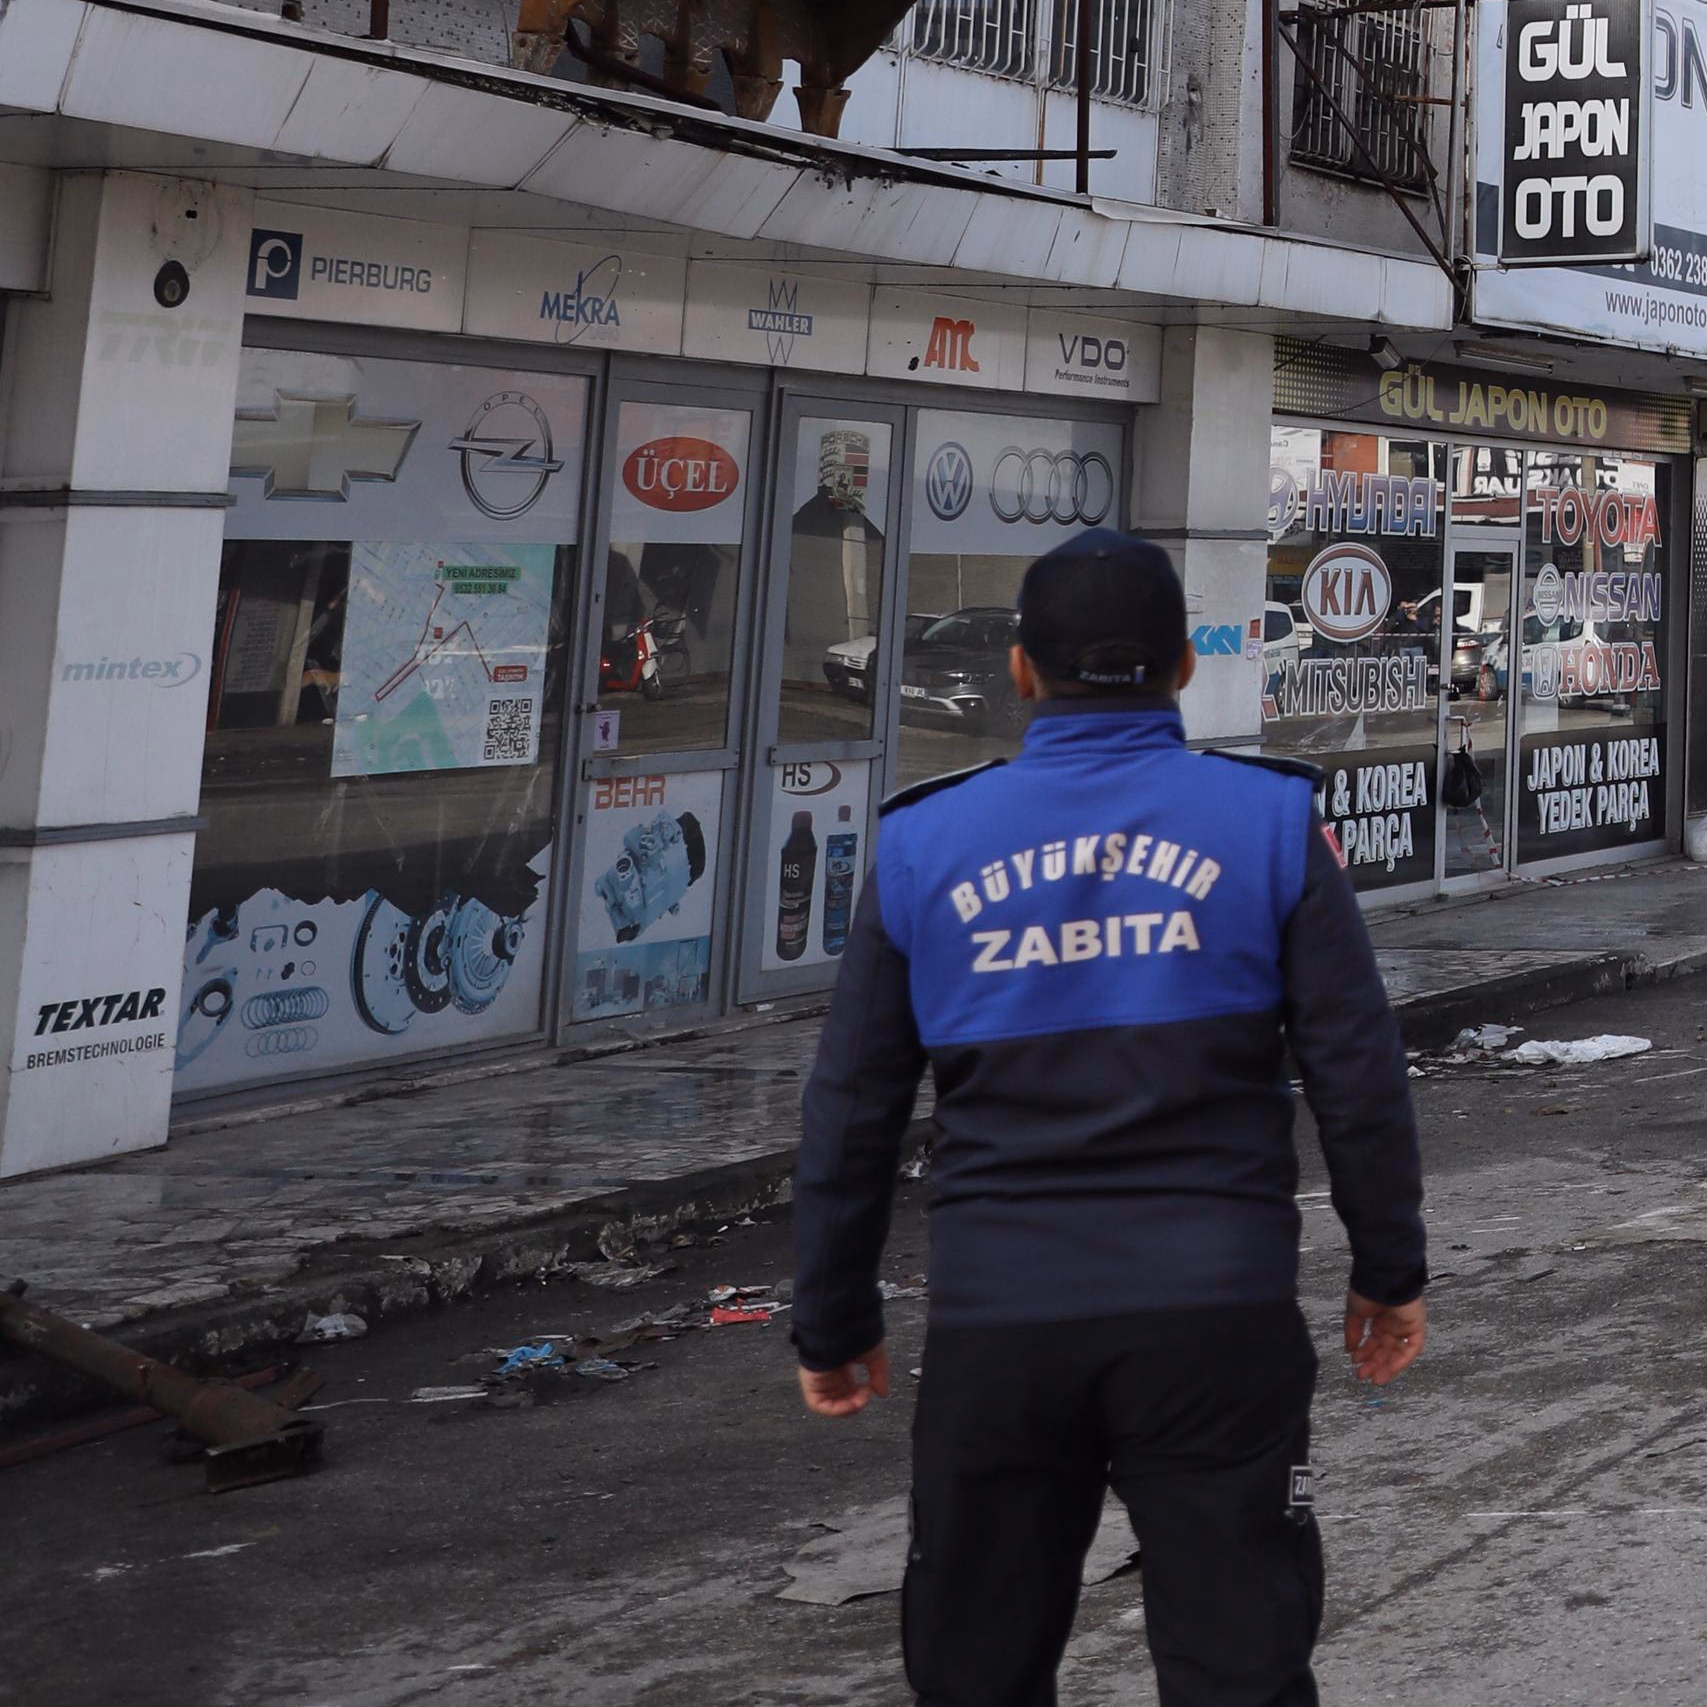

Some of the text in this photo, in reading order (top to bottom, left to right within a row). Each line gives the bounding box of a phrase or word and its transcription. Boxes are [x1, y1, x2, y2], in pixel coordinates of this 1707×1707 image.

[1518, 4, 1628, 83] GÜL
[1513, 98, 1630, 161] JAPON
[1515, 174, 1625, 240] OTO
[311, 256, 433, 293] PIERBURG
[1651, 244, 1682, 282] 0362
[540, 270, 621, 327] MEKRA
[750, 309, 811, 334] WAHLER
[1058, 332, 1126, 371] VDO
[1055, 368, 1130, 388] Performance Instruments
[1380, 363, 1608, 439] GÜL JAPON OTO
[636, 448, 728, 499] ÜÇEL
[1306, 469, 1438, 537] HYUNDAI
[1536, 485, 1663, 547] TOYOTA
[446, 566, 516, 579] YENİ ADRESİMİZ
[1319, 568, 1377, 616] KIA
[1564, 571, 1662, 623] NISSAN
[61, 656, 183, 682] mintex
[1283, 655, 1428, 718] MITSUBISHI
[1558, 641, 1662, 696] HONDA
[781, 761, 812, 787] HS
[1332, 761, 1429, 818] & KOREA
[1527, 737, 1661, 791] JAPON & KOREA
[594, 774, 667, 811] BEHR
[1537, 780, 1651, 836] YEDEK PARÇA
[1341, 811, 1415, 872] PARÇA
[784, 863, 800, 879] HS
[971, 911, 1201, 974] ZABITA
[34, 987, 167, 1036] TEXTAR
[27, 1032, 166, 1070] BREMSTECHNOLOGIE
